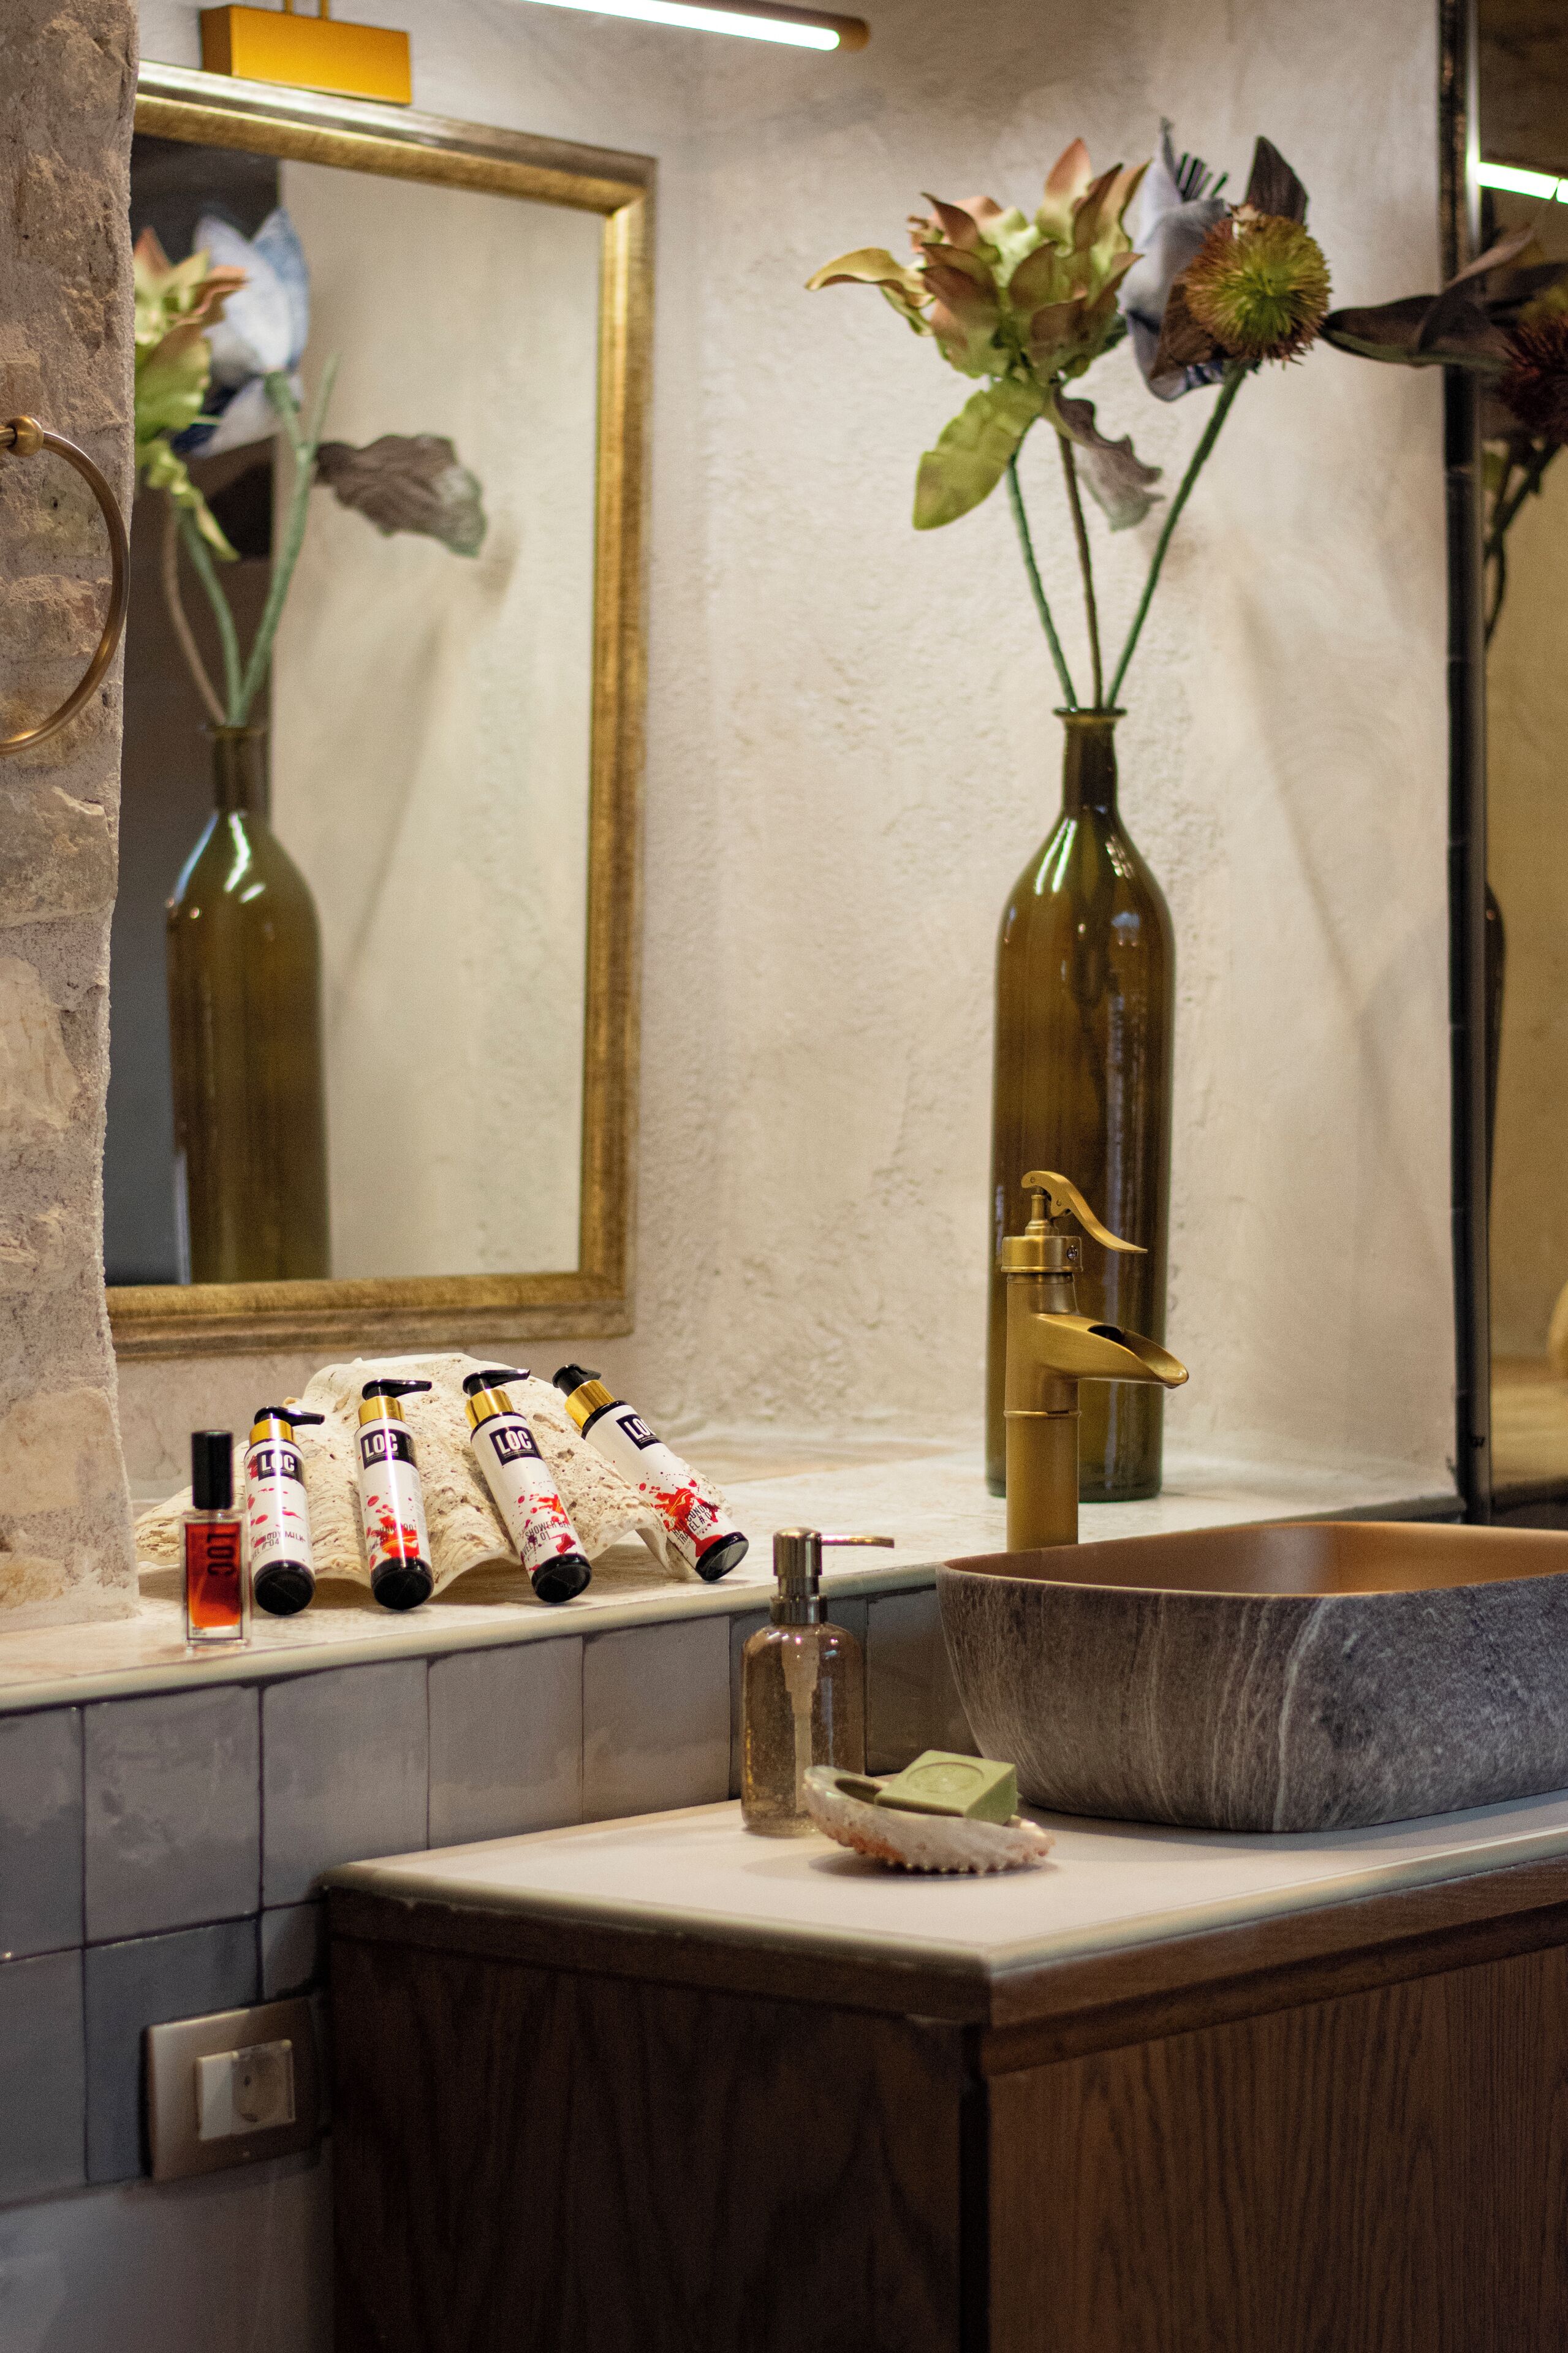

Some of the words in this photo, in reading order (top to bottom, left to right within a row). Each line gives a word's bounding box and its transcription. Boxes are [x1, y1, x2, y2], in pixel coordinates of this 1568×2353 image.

[365, 1433, 398, 1458] LOC
[496, 1430, 532, 1454] LOC
[261, 1453, 295, 1472] LOC
[525, 1520, 557, 1537] SHOWER
[678, 1521, 700, 1545] TRAEL
[206, 1534, 237, 1576] LOC
